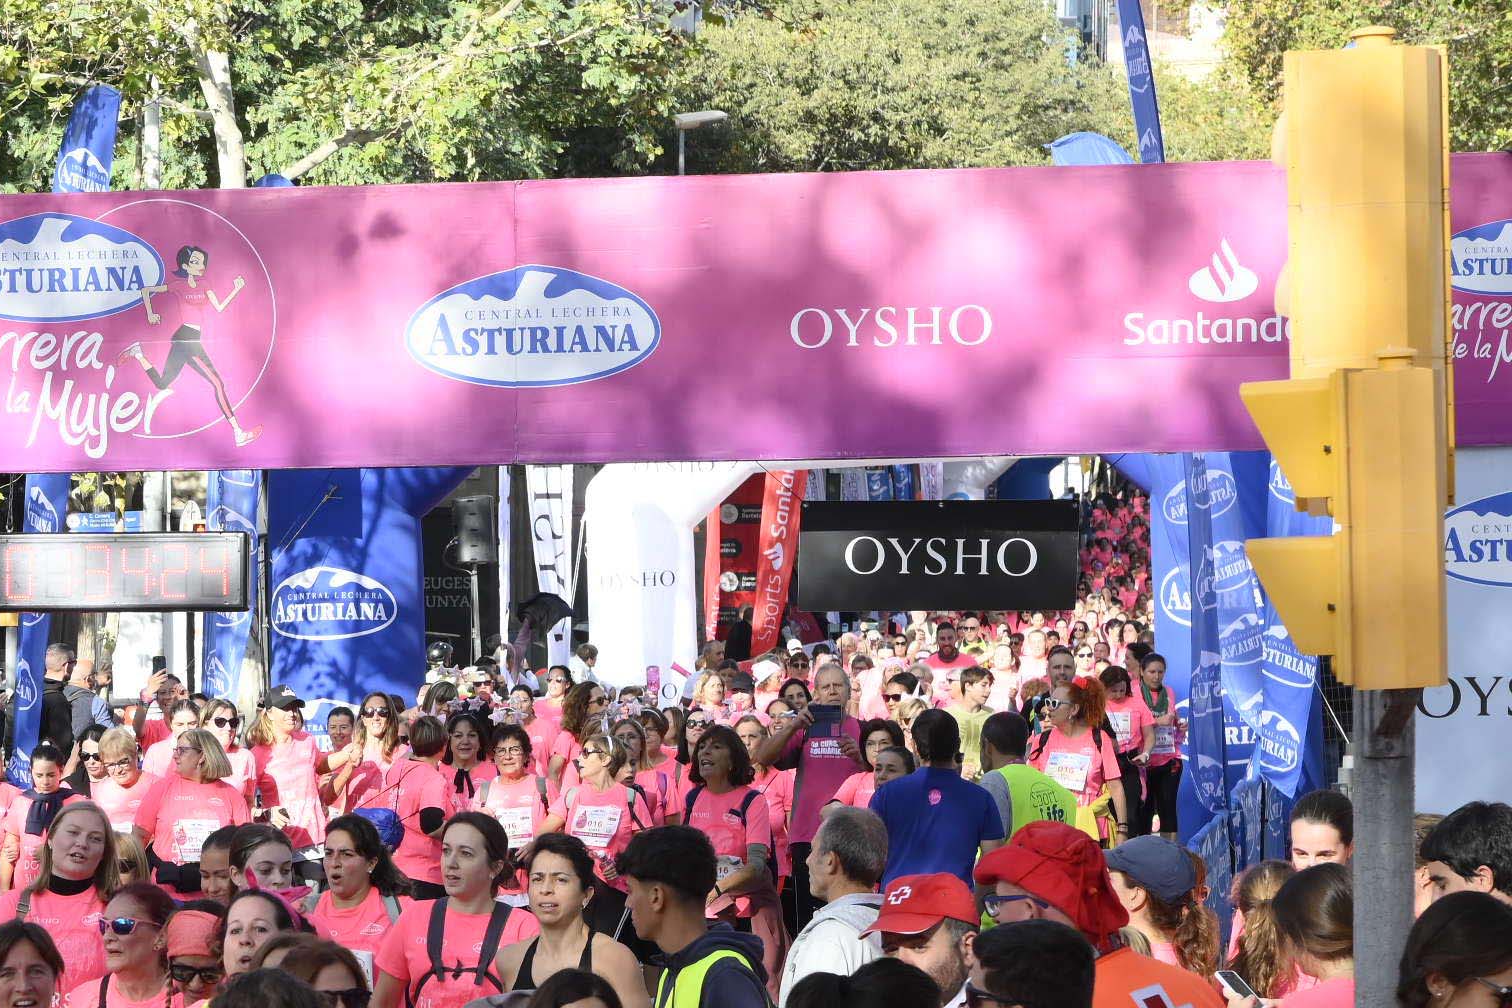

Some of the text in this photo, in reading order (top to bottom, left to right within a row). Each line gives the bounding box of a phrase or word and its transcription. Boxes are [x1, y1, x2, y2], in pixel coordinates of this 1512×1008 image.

[66, 248, 140, 261] LECHERA
[1451, 249, 1512, 277] STU
[464, 305, 632, 321] CENTRAL LECHERA
[790, 304, 993, 349] OYSHO
[425, 311, 640, 357] ASTURIANA
[1473, 331, 1492, 359] la
[6, 372, 29, 413] la
[25, 365, 175, 458] Mujer
[844, 535, 1038, 577] OYSHO
[287, 590, 384, 601] CENTRAL LECHERA
[758, 575, 782, 641] Sports
[274, 600, 390, 624] ASTURIANA
[1416, 676, 1512, 719] OY
[587, 820, 603, 828] 016
